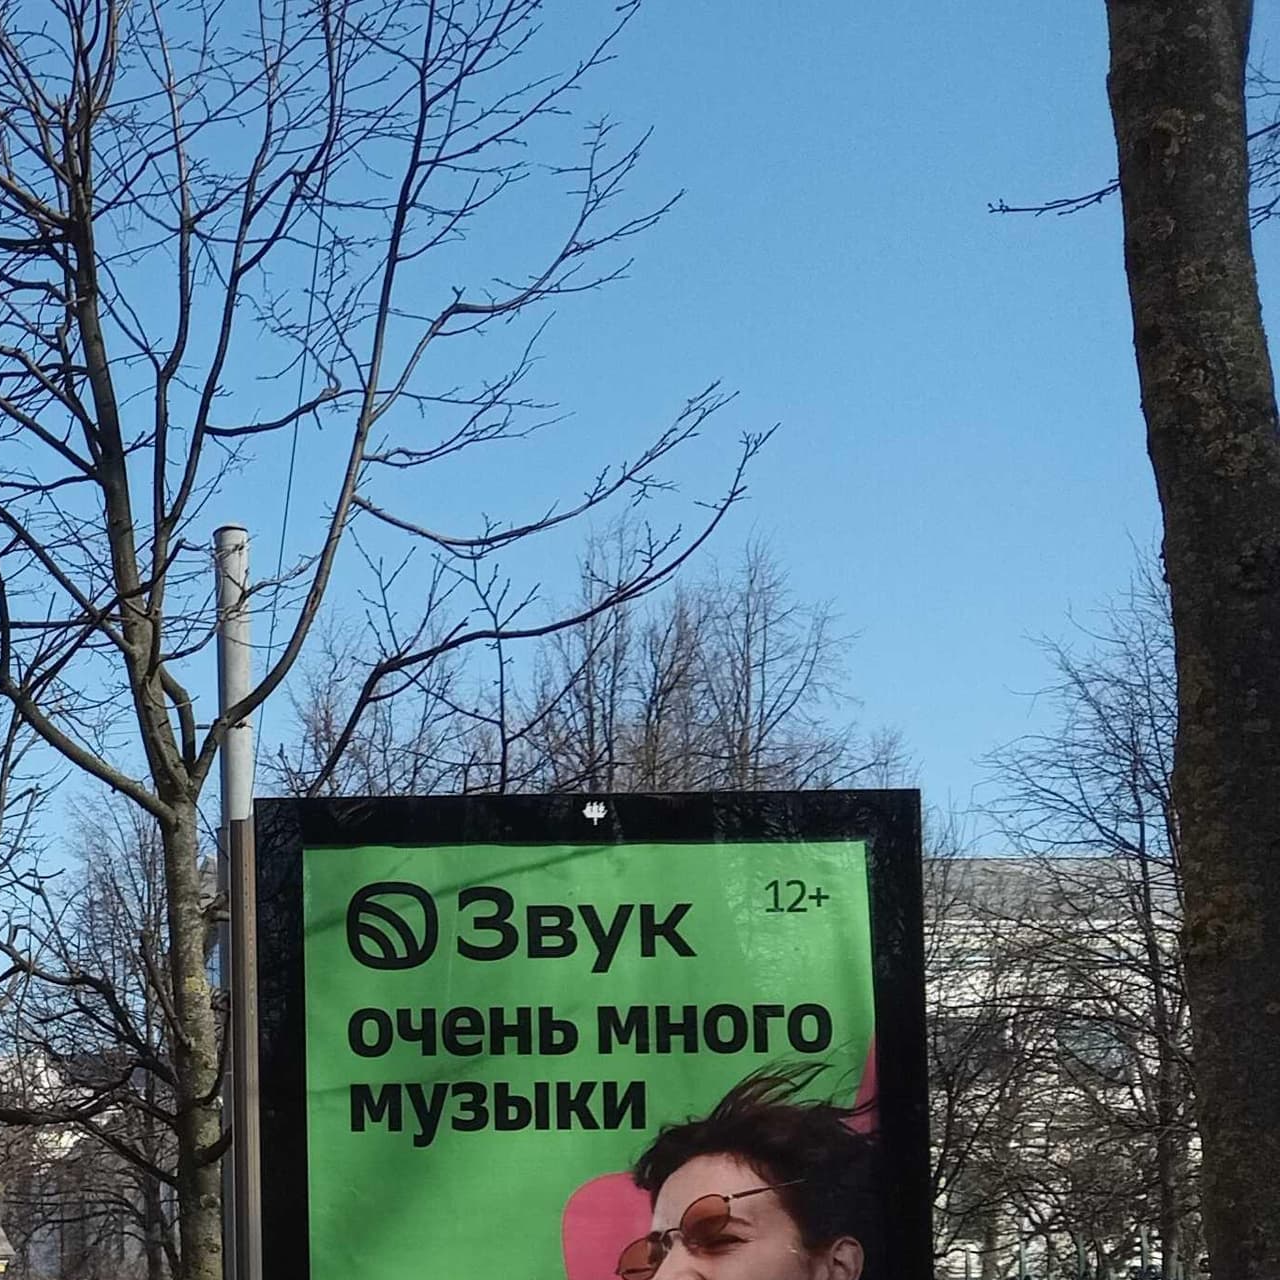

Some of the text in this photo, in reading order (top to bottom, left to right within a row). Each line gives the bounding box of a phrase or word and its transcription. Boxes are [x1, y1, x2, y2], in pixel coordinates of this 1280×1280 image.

[765, 879, 830, 913] 12+
[457, 887, 696, 973] Звук
[348, 1002, 833, 1058] очень много
[350, 1079, 646, 1147] музыки
